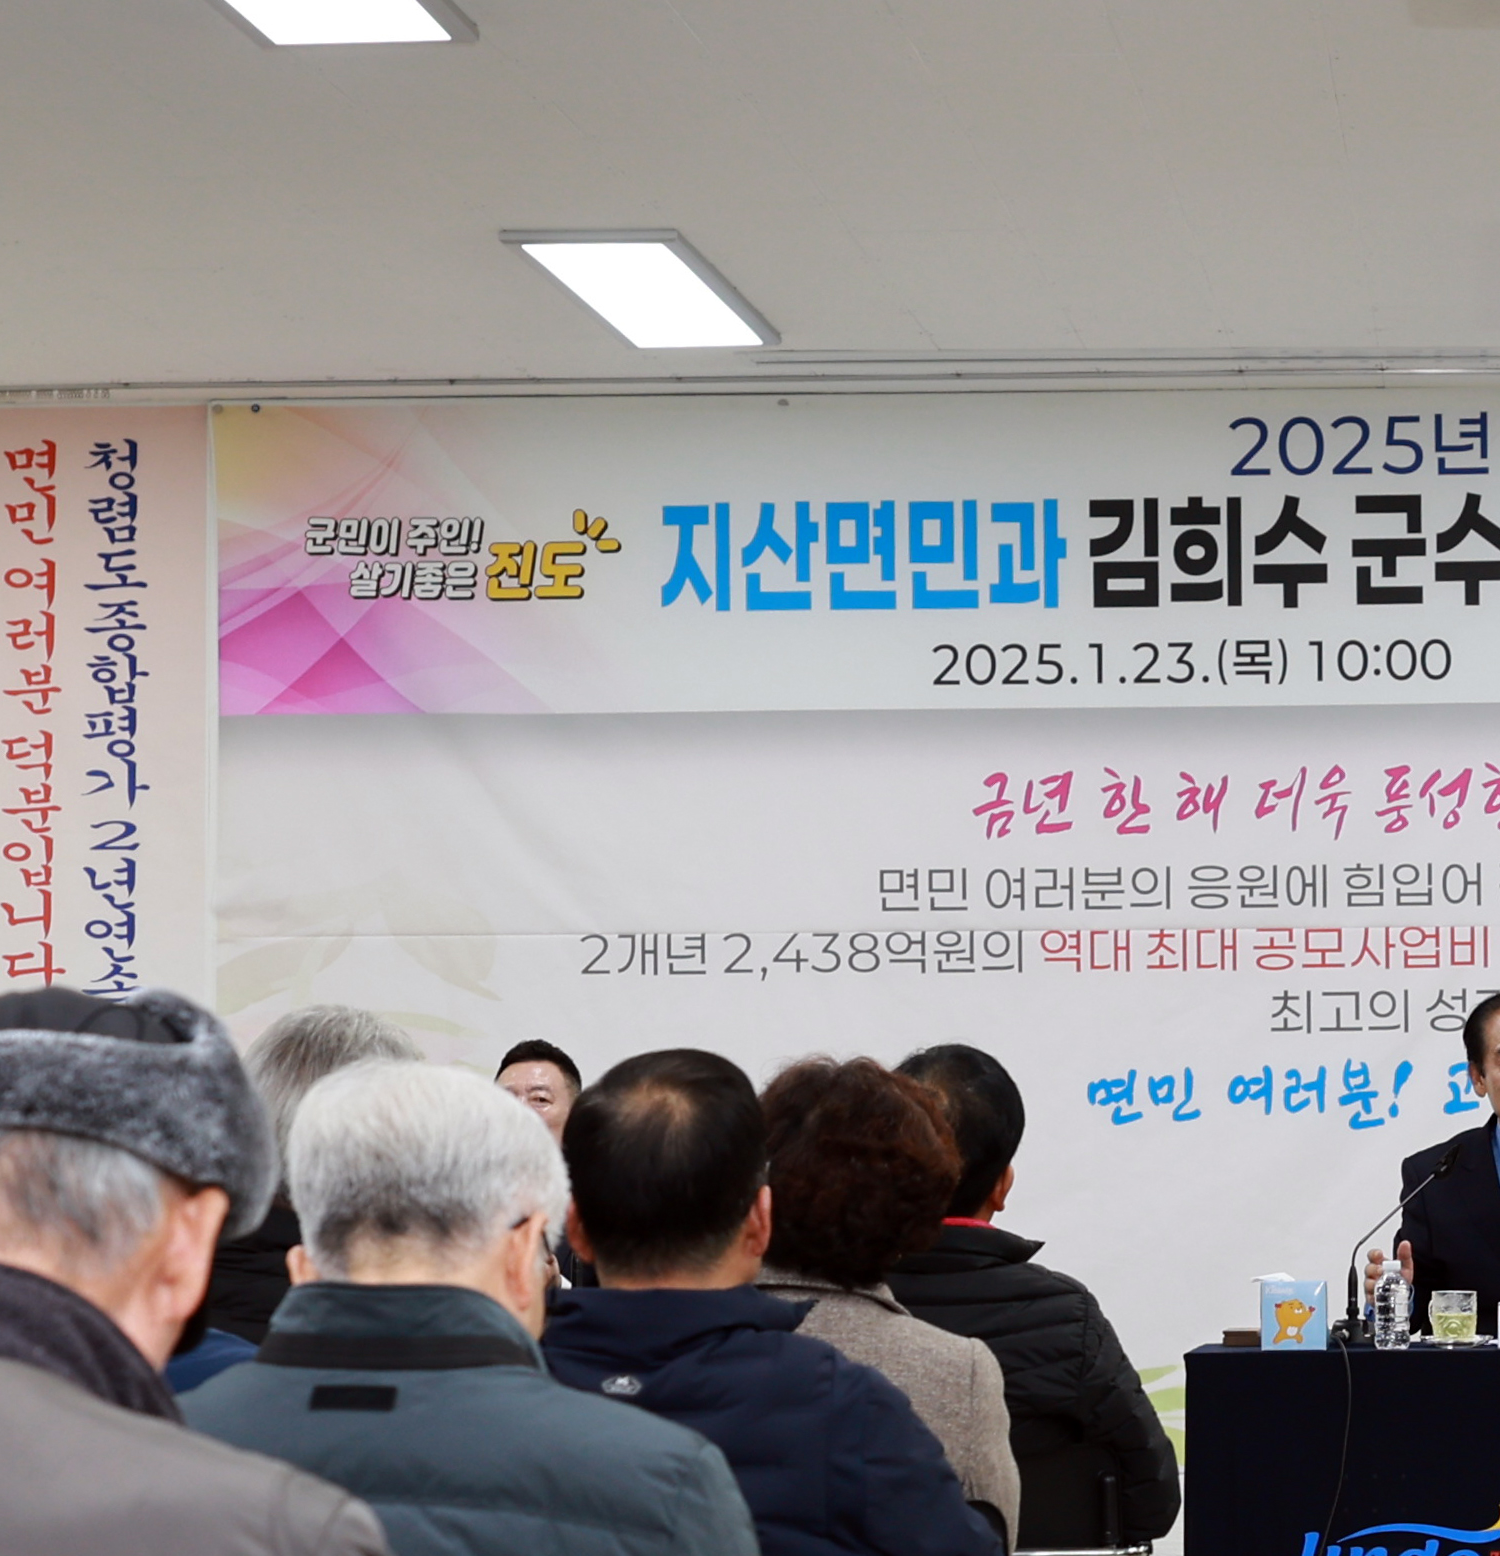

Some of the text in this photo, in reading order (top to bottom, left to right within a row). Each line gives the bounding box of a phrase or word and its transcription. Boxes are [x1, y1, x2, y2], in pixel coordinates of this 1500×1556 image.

[1229, 410, 1491, 478] 2025년
[305, 516, 485, 556] 군민이 주인!
[662, 498, 1068, 611] 지산면민과
[1089, 494, 1330, 610] 김희수
[349, 540, 588, 601] 살기좋은 진도
[933, 638, 1454, 688] 2025.1.23.(목) 10:00
[0, 438, 66, 988] 면민 여러분 덕분입니다
[973, 771, 1076, 841] 금년
[1101, 767, 1152, 837] 한
[1176, 772, 1230, 834] 해
[1255, 765, 1352, 842] 더욱
[880, 868, 970, 913] 면민
[986, 866, 1172, 913] 여러분의
[1188, 864, 1329, 911] 응원에
[1344, 863, 1483, 909] 힘입어
[581, 932, 708, 977] 2개년
[724, 930, 1024, 983] 2,438억원의
[1041, 929, 1132, 974] 역대
[1147, 928, 1239, 973] 최대
[1253, 926, 1490, 972] 공모사업비
[1271, 989, 1410, 1036] 최고의
[1087, 1068, 1202, 1125] 면민
[1227, 1058, 1414, 1130] 여러분!
